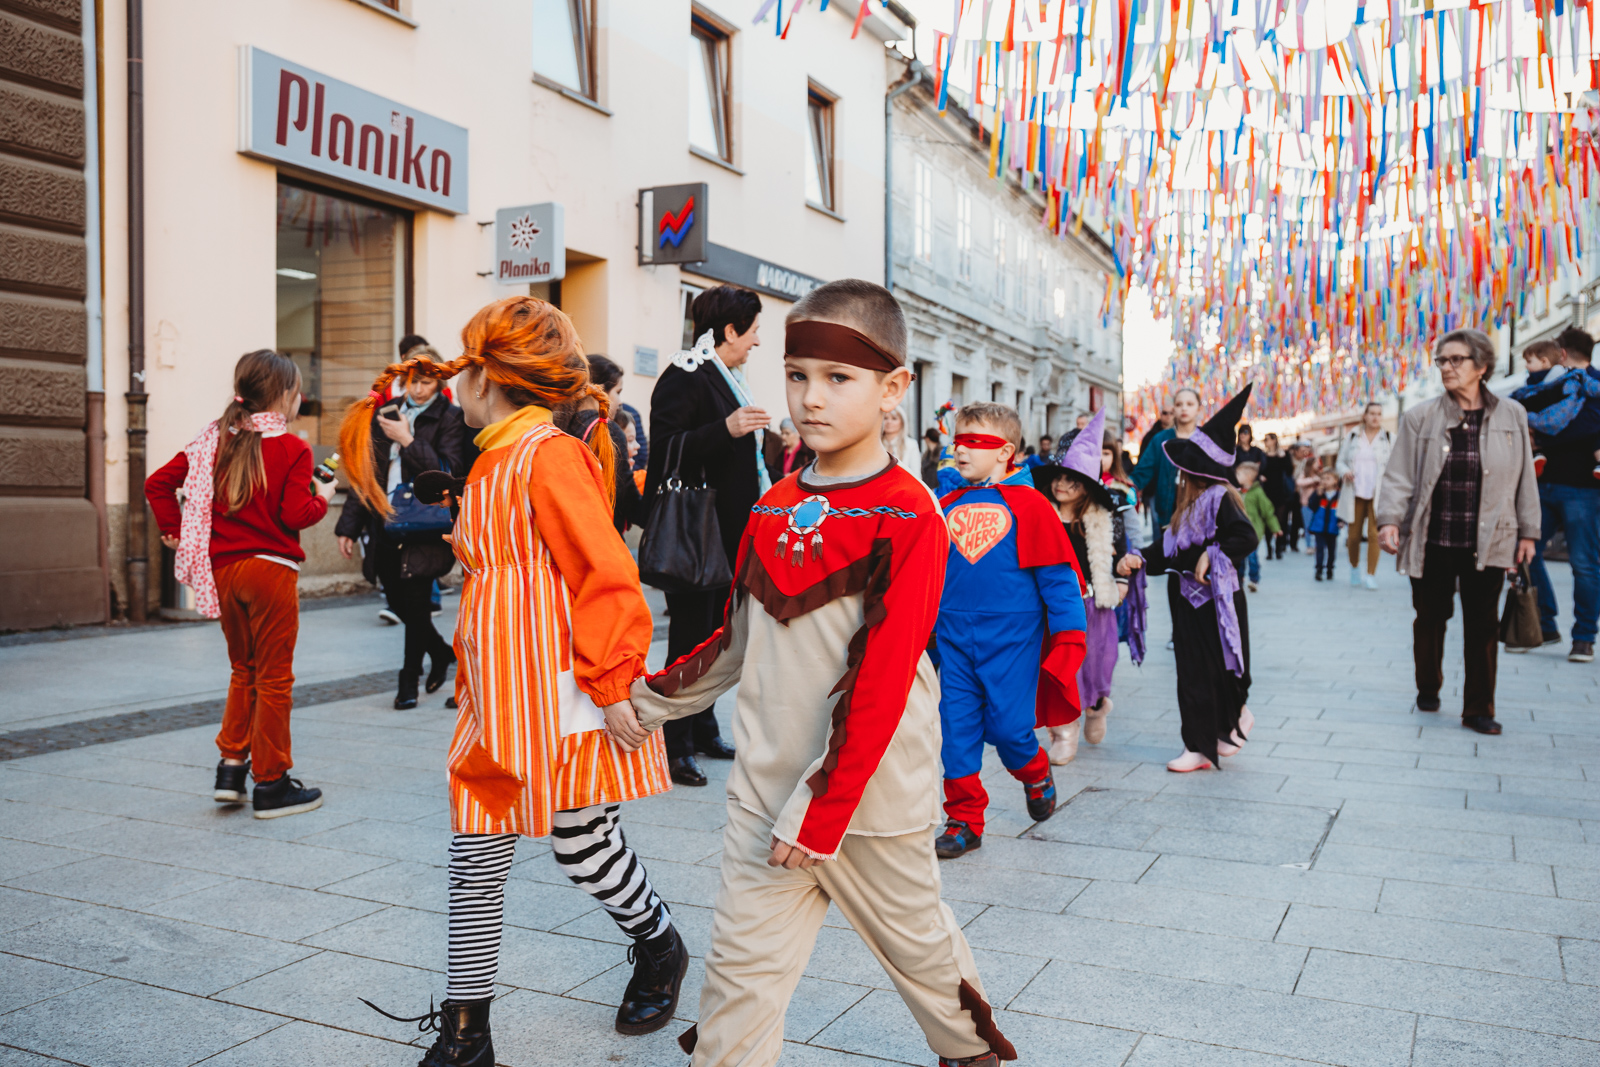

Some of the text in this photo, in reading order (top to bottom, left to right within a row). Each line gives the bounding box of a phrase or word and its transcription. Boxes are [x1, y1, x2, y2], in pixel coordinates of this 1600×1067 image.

[276, 68, 452, 197] Planika
[499, 257, 550, 278] Planika
[952, 506, 999, 537] SUPER
[964, 527, 997, 556] HERO
